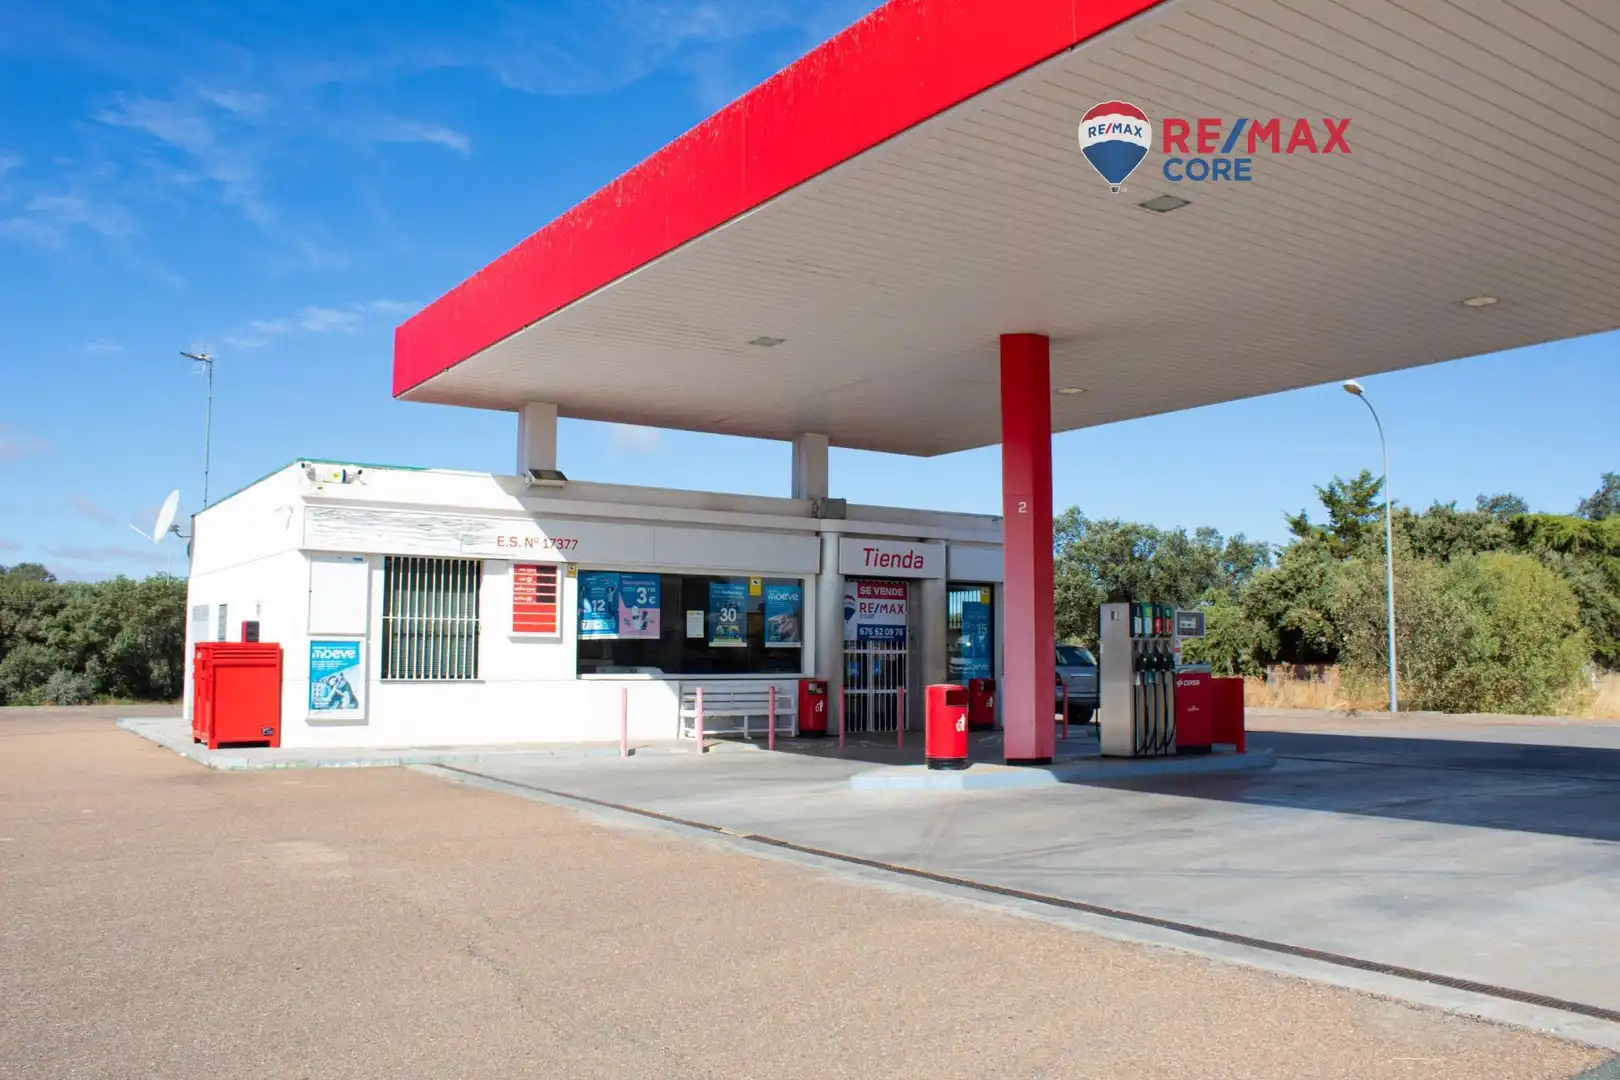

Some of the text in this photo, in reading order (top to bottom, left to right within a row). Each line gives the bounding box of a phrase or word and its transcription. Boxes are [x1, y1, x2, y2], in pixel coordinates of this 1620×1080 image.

[1017, 501, 1028, 514] 2
[497, 536, 522, 548] E.S.
[542, 538, 579, 551] 17377
[863, 548, 924, 569] Tienda
[636, 587, 648, 604] 3
[768, 592, 799, 601] moeve
[860, 586, 904, 596] SE VENDE
[591, 600, 606, 612] 12
[859, 603, 904, 614] RE/MAX
[720, 608, 737, 622] 30
[312, 649, 357, 659] moeve
